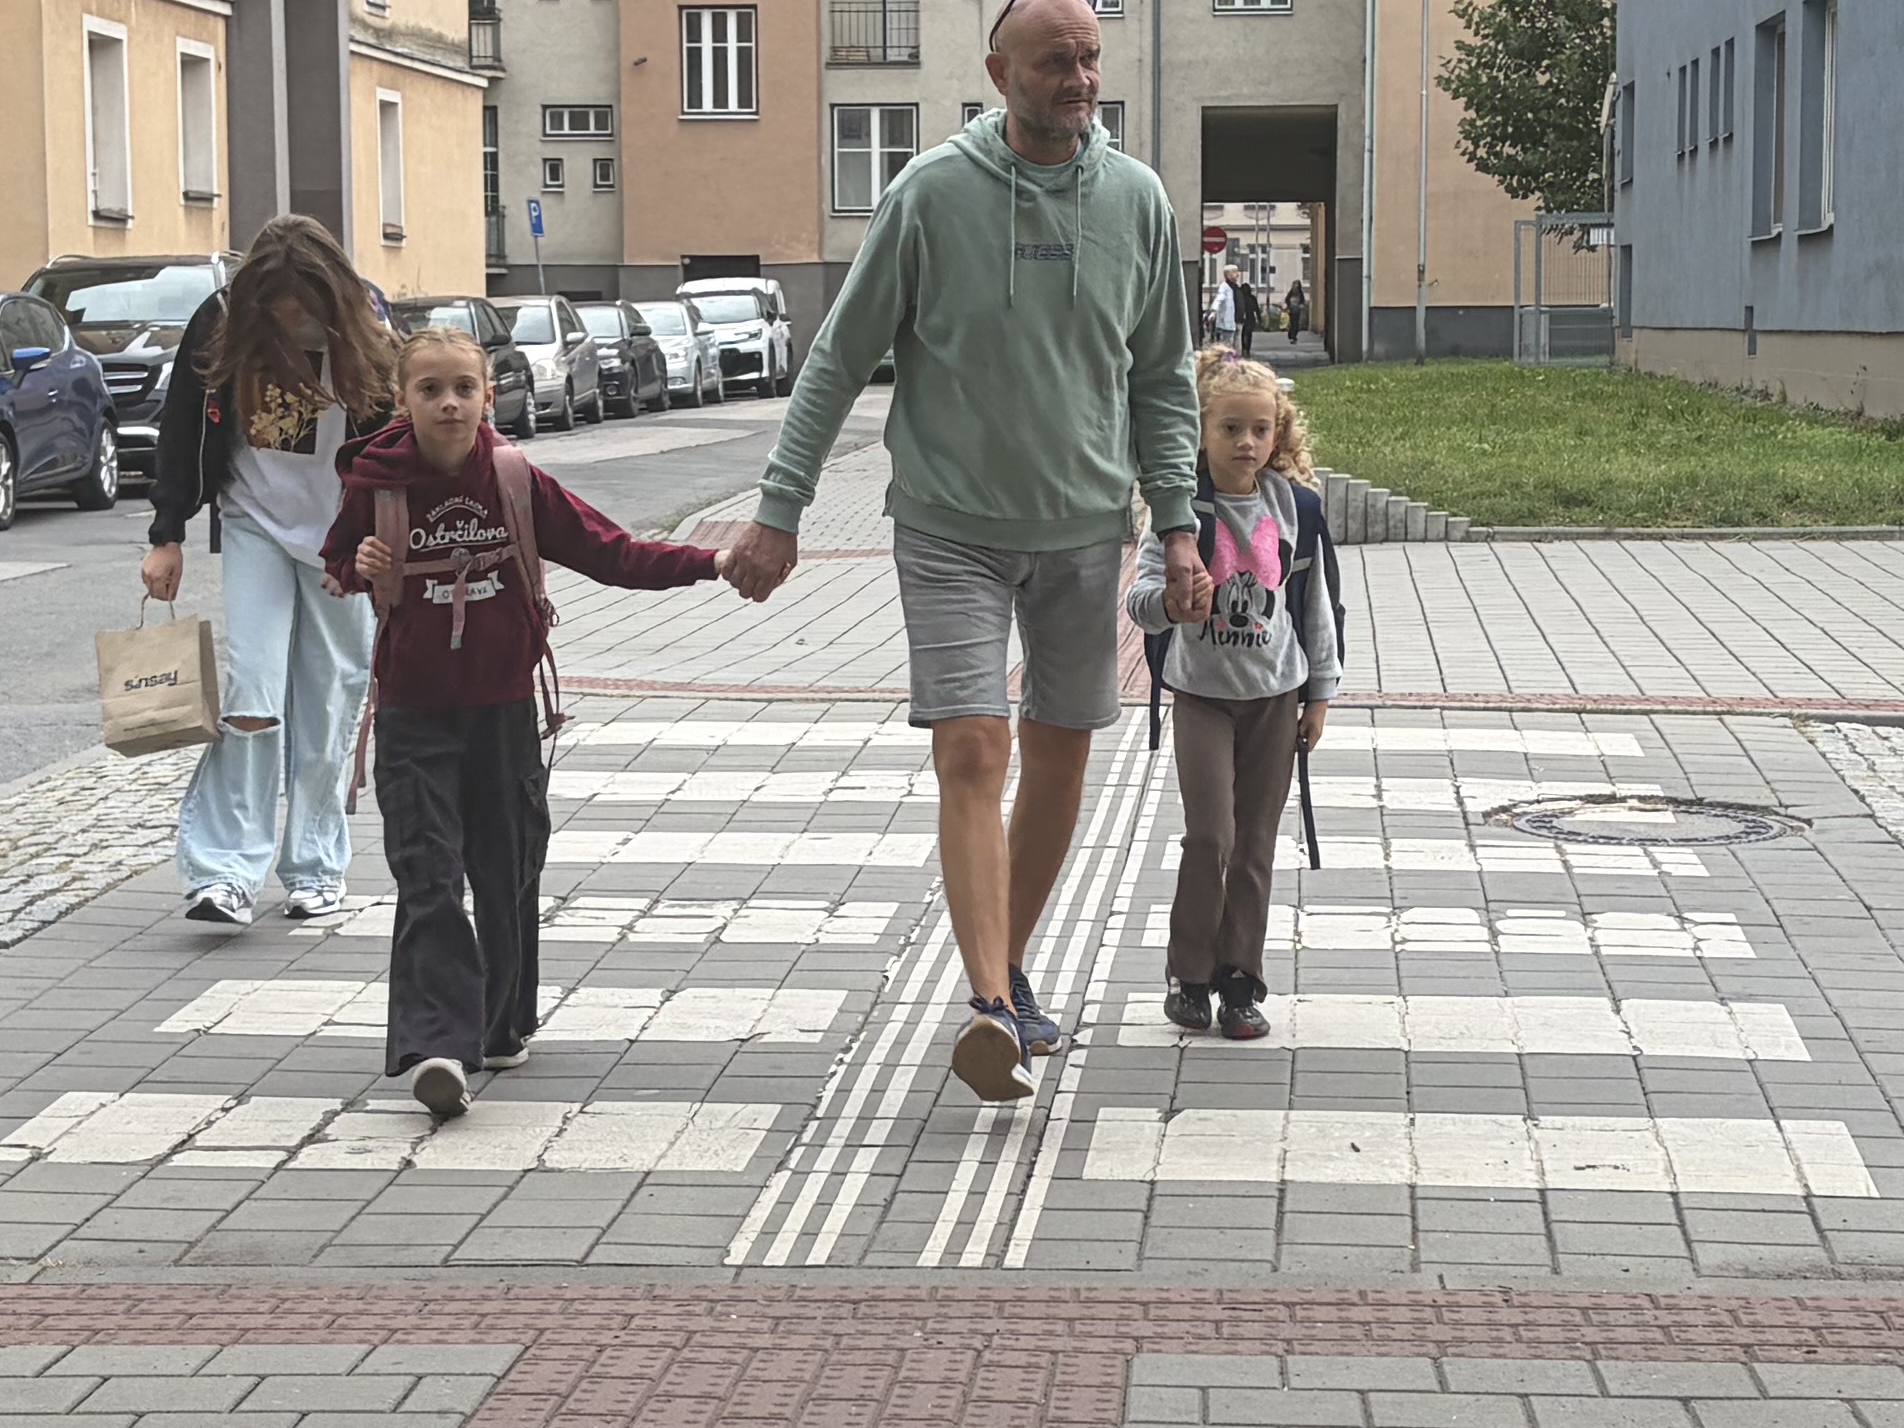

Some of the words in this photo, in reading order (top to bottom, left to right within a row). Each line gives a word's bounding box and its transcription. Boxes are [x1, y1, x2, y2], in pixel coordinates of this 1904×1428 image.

[530, 202, 540, 224] P
[409, 518, 508, 549] Ostrčilova
[124, 670, 178, 692] sinsay
